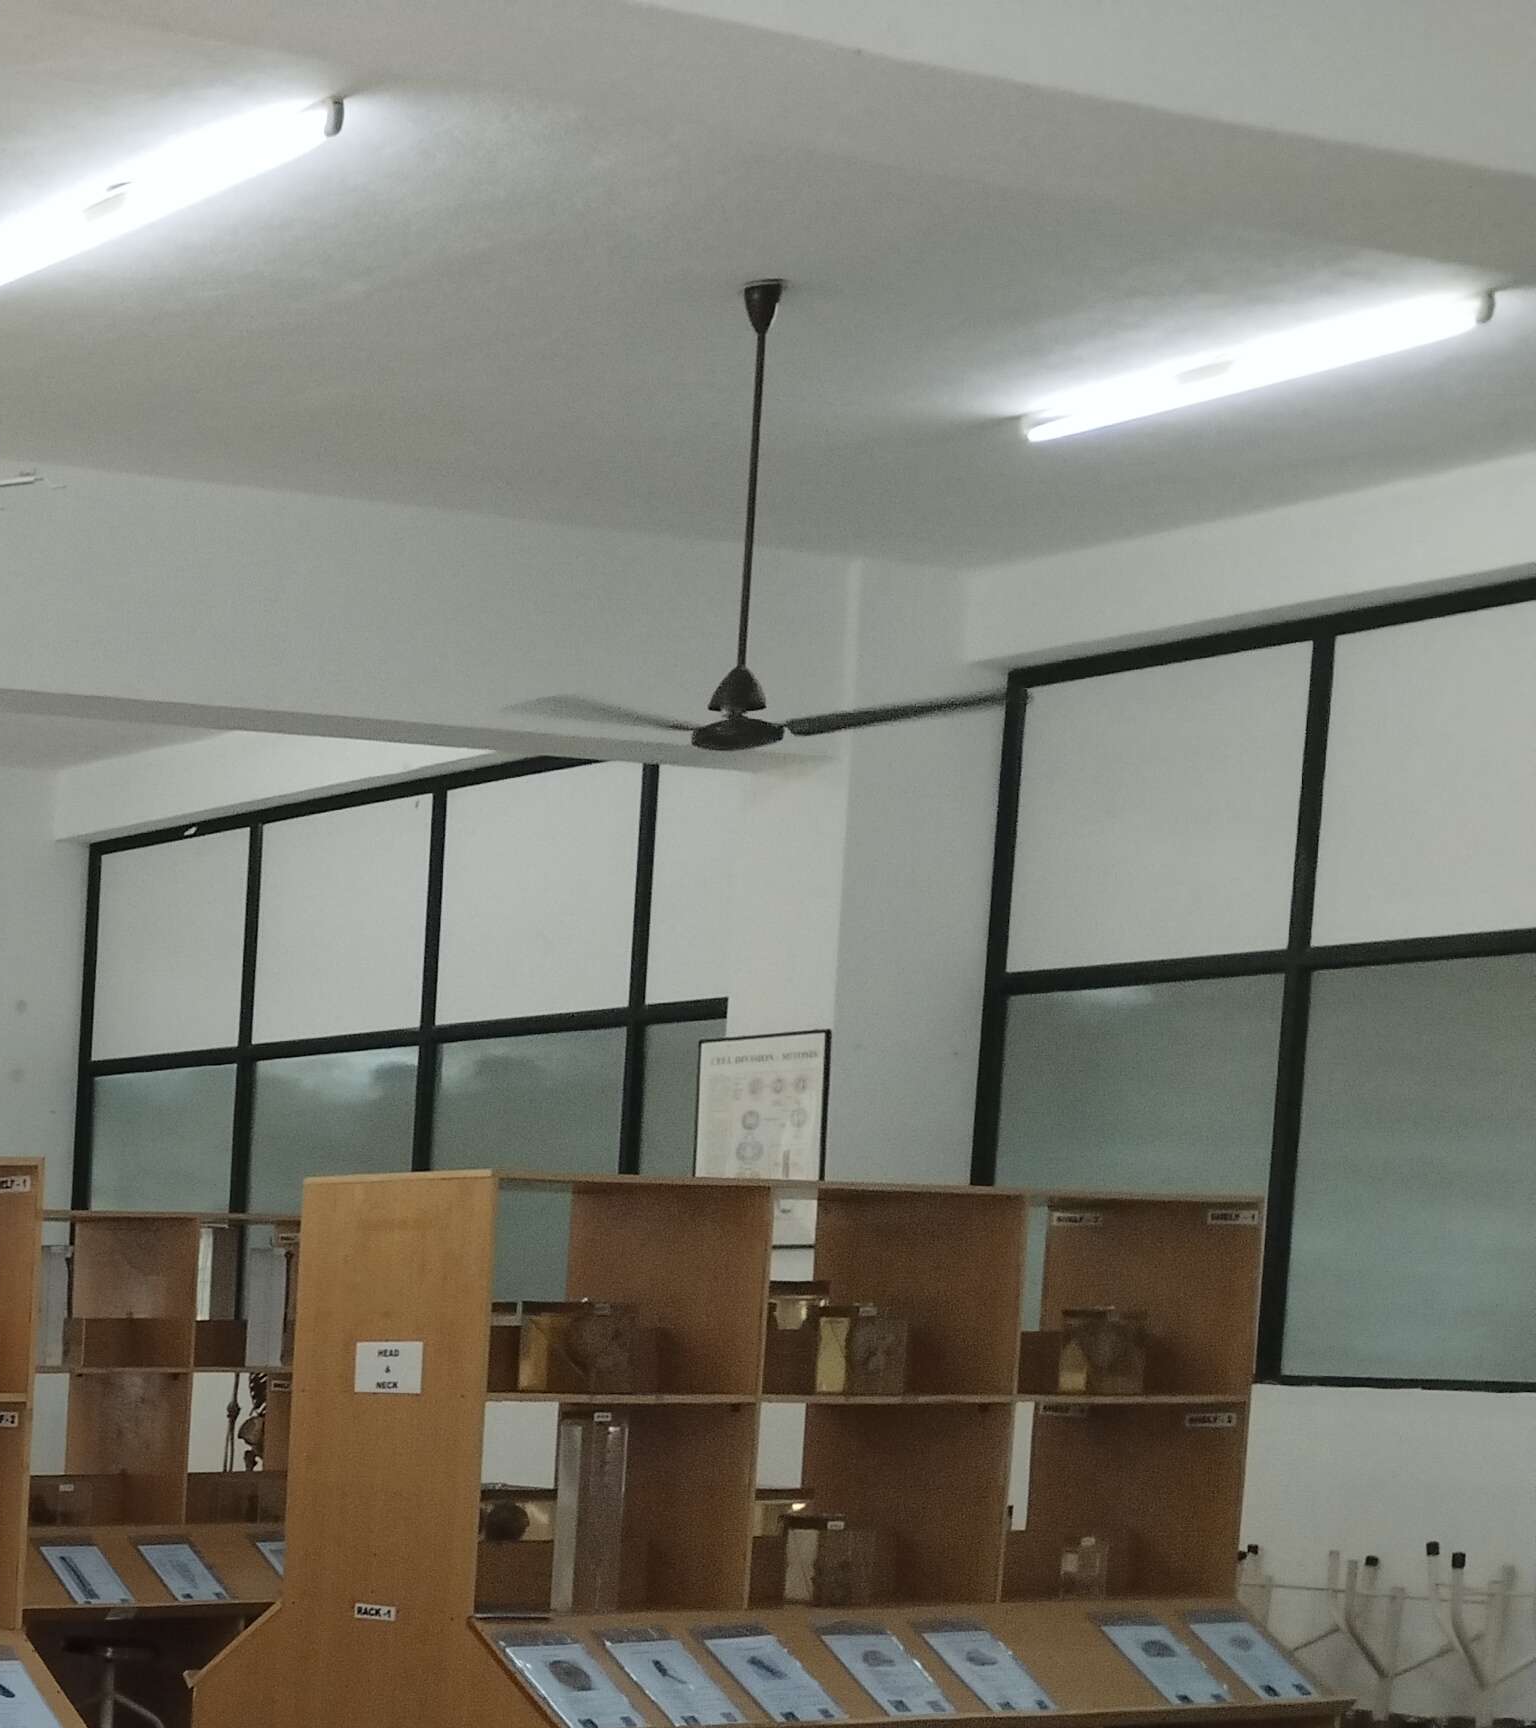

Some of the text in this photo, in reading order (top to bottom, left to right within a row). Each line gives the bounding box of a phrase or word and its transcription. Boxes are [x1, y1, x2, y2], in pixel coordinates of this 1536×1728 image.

[377, 1348, 400, 1358] HEAD
[375, 1381, 399, 1390] NECK
[357, 1606, 382, 1618] RACK
